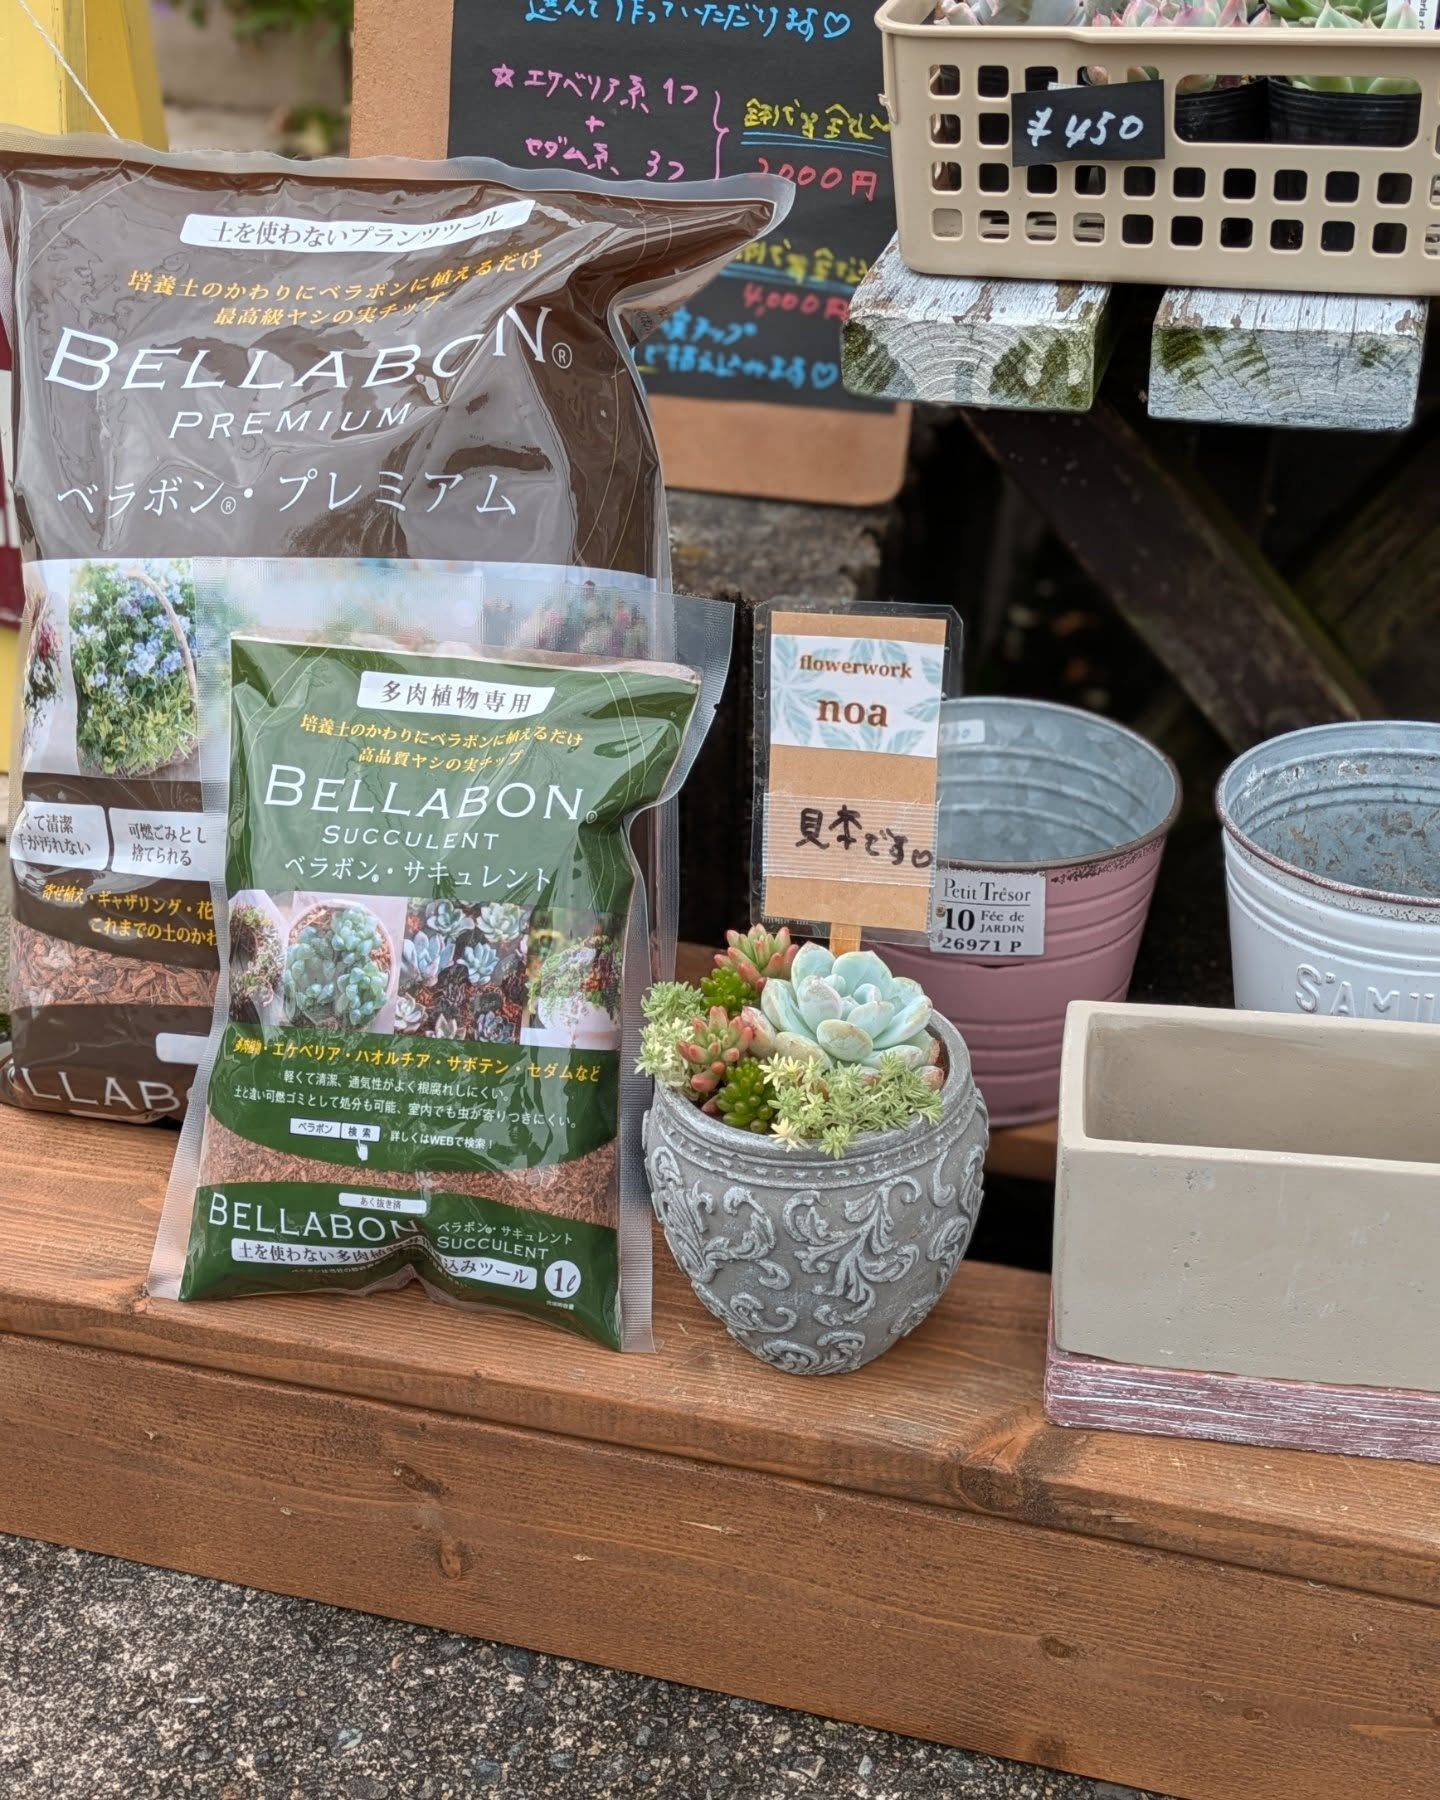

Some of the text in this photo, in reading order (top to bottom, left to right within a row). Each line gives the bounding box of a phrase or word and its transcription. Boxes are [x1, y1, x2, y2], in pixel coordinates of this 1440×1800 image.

[211, 208, 504, 249] 土を使わないプランツツール
[127, 249, 543, 302] 培養土のかわりにベラボンに植えるだけ
[213, 293, 446, 327] 最高級ヤシの実チップ
[168, 402, 412, 440] PREMIUM
[800, 655, 912, 679] flowerwork
[381, 680, 534, 714] 多肉植物専用
[816, 700, 888, 727] noa
[300, 713, 584, 750] 培養土のかわりにベラボンに植えるだけ
[358, 747, 524, 774] 高品質ヤシの実チップ
[321, 825, 500, 852] SUCCULENT
[131, 843, 193, 867] 捨てられる
[943, 878, 977, 900] Petit
[943, 907, 975, 932] 10
[980, 924, 1025, 934] JARDIN
[1009, 912, 1024, 922] de
[941, 937, 1022, 953] 26971 P
[297, 1122, 334, 1136] ベラボン
[437, 1235, 550, 1261] SUCCULENT
